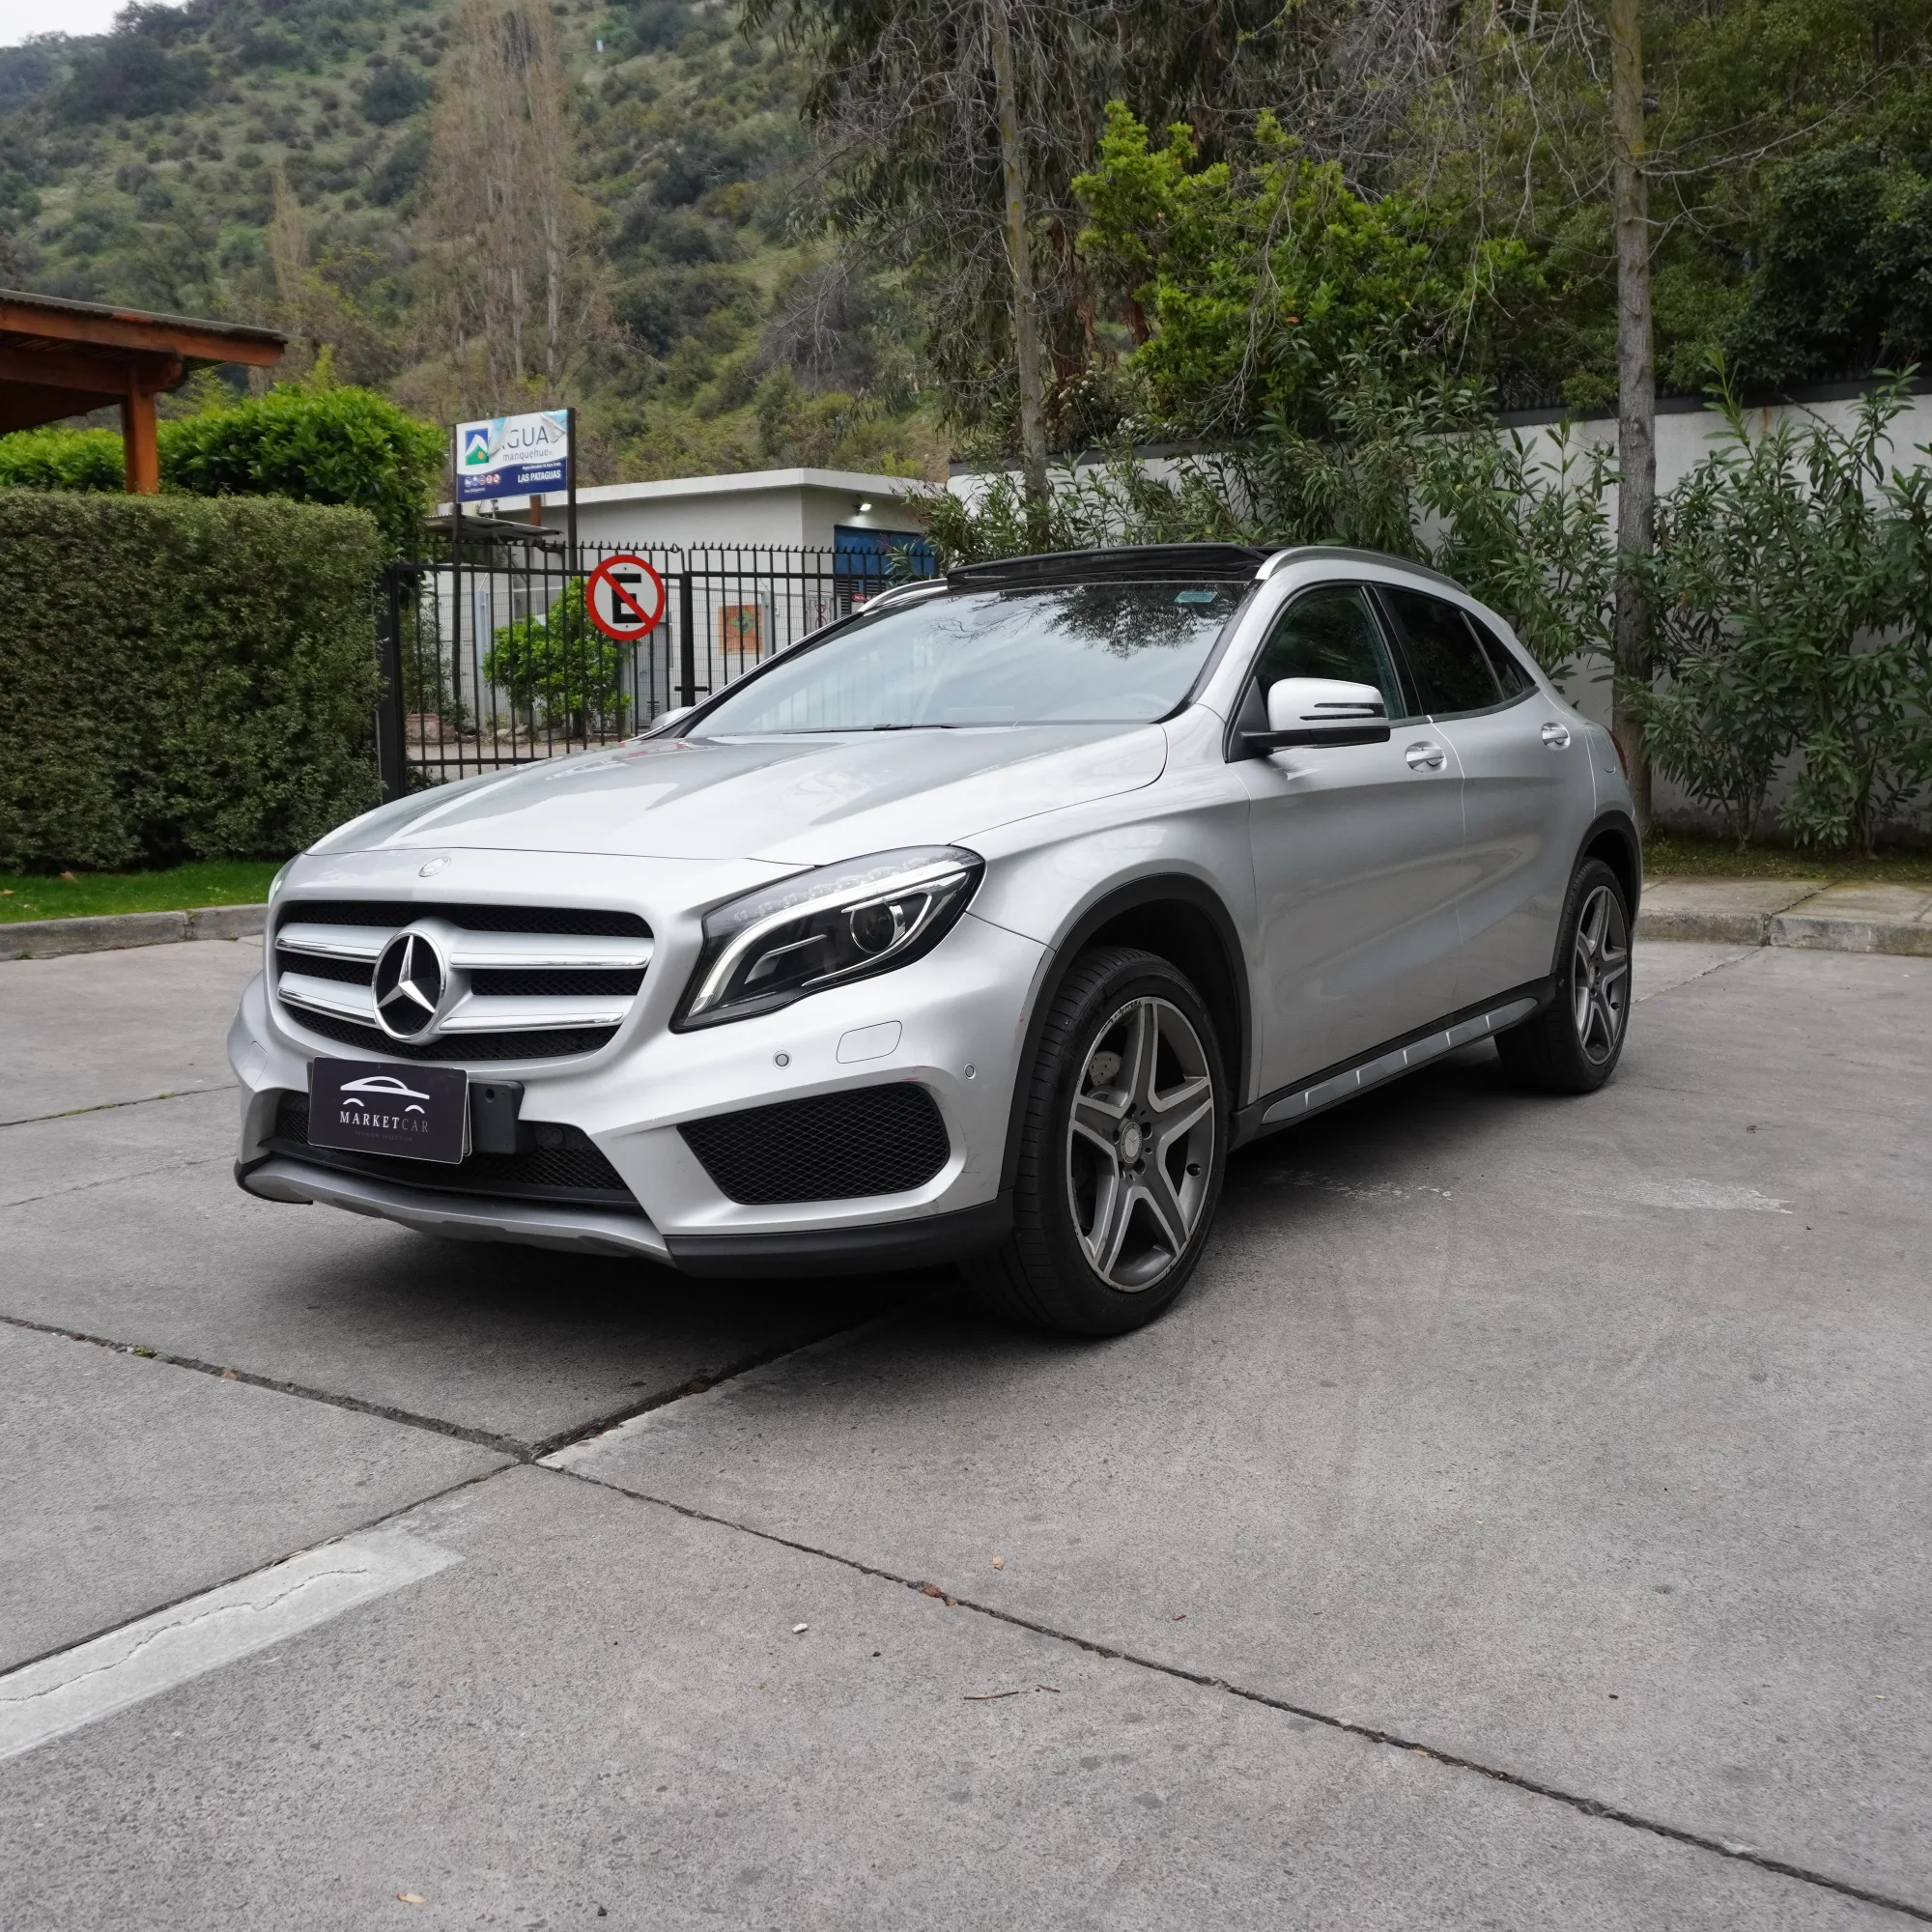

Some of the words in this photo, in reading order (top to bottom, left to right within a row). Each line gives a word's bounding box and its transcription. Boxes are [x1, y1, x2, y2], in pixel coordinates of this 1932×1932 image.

[502, 448, 549, 462] manquehue
[517, 473, 529, 483] LAS
[530, 469, 561, 481] PATAGUAS
[611, 573, 642, 624] E
[339, 1111, 429, 1133] MARKETCAR
